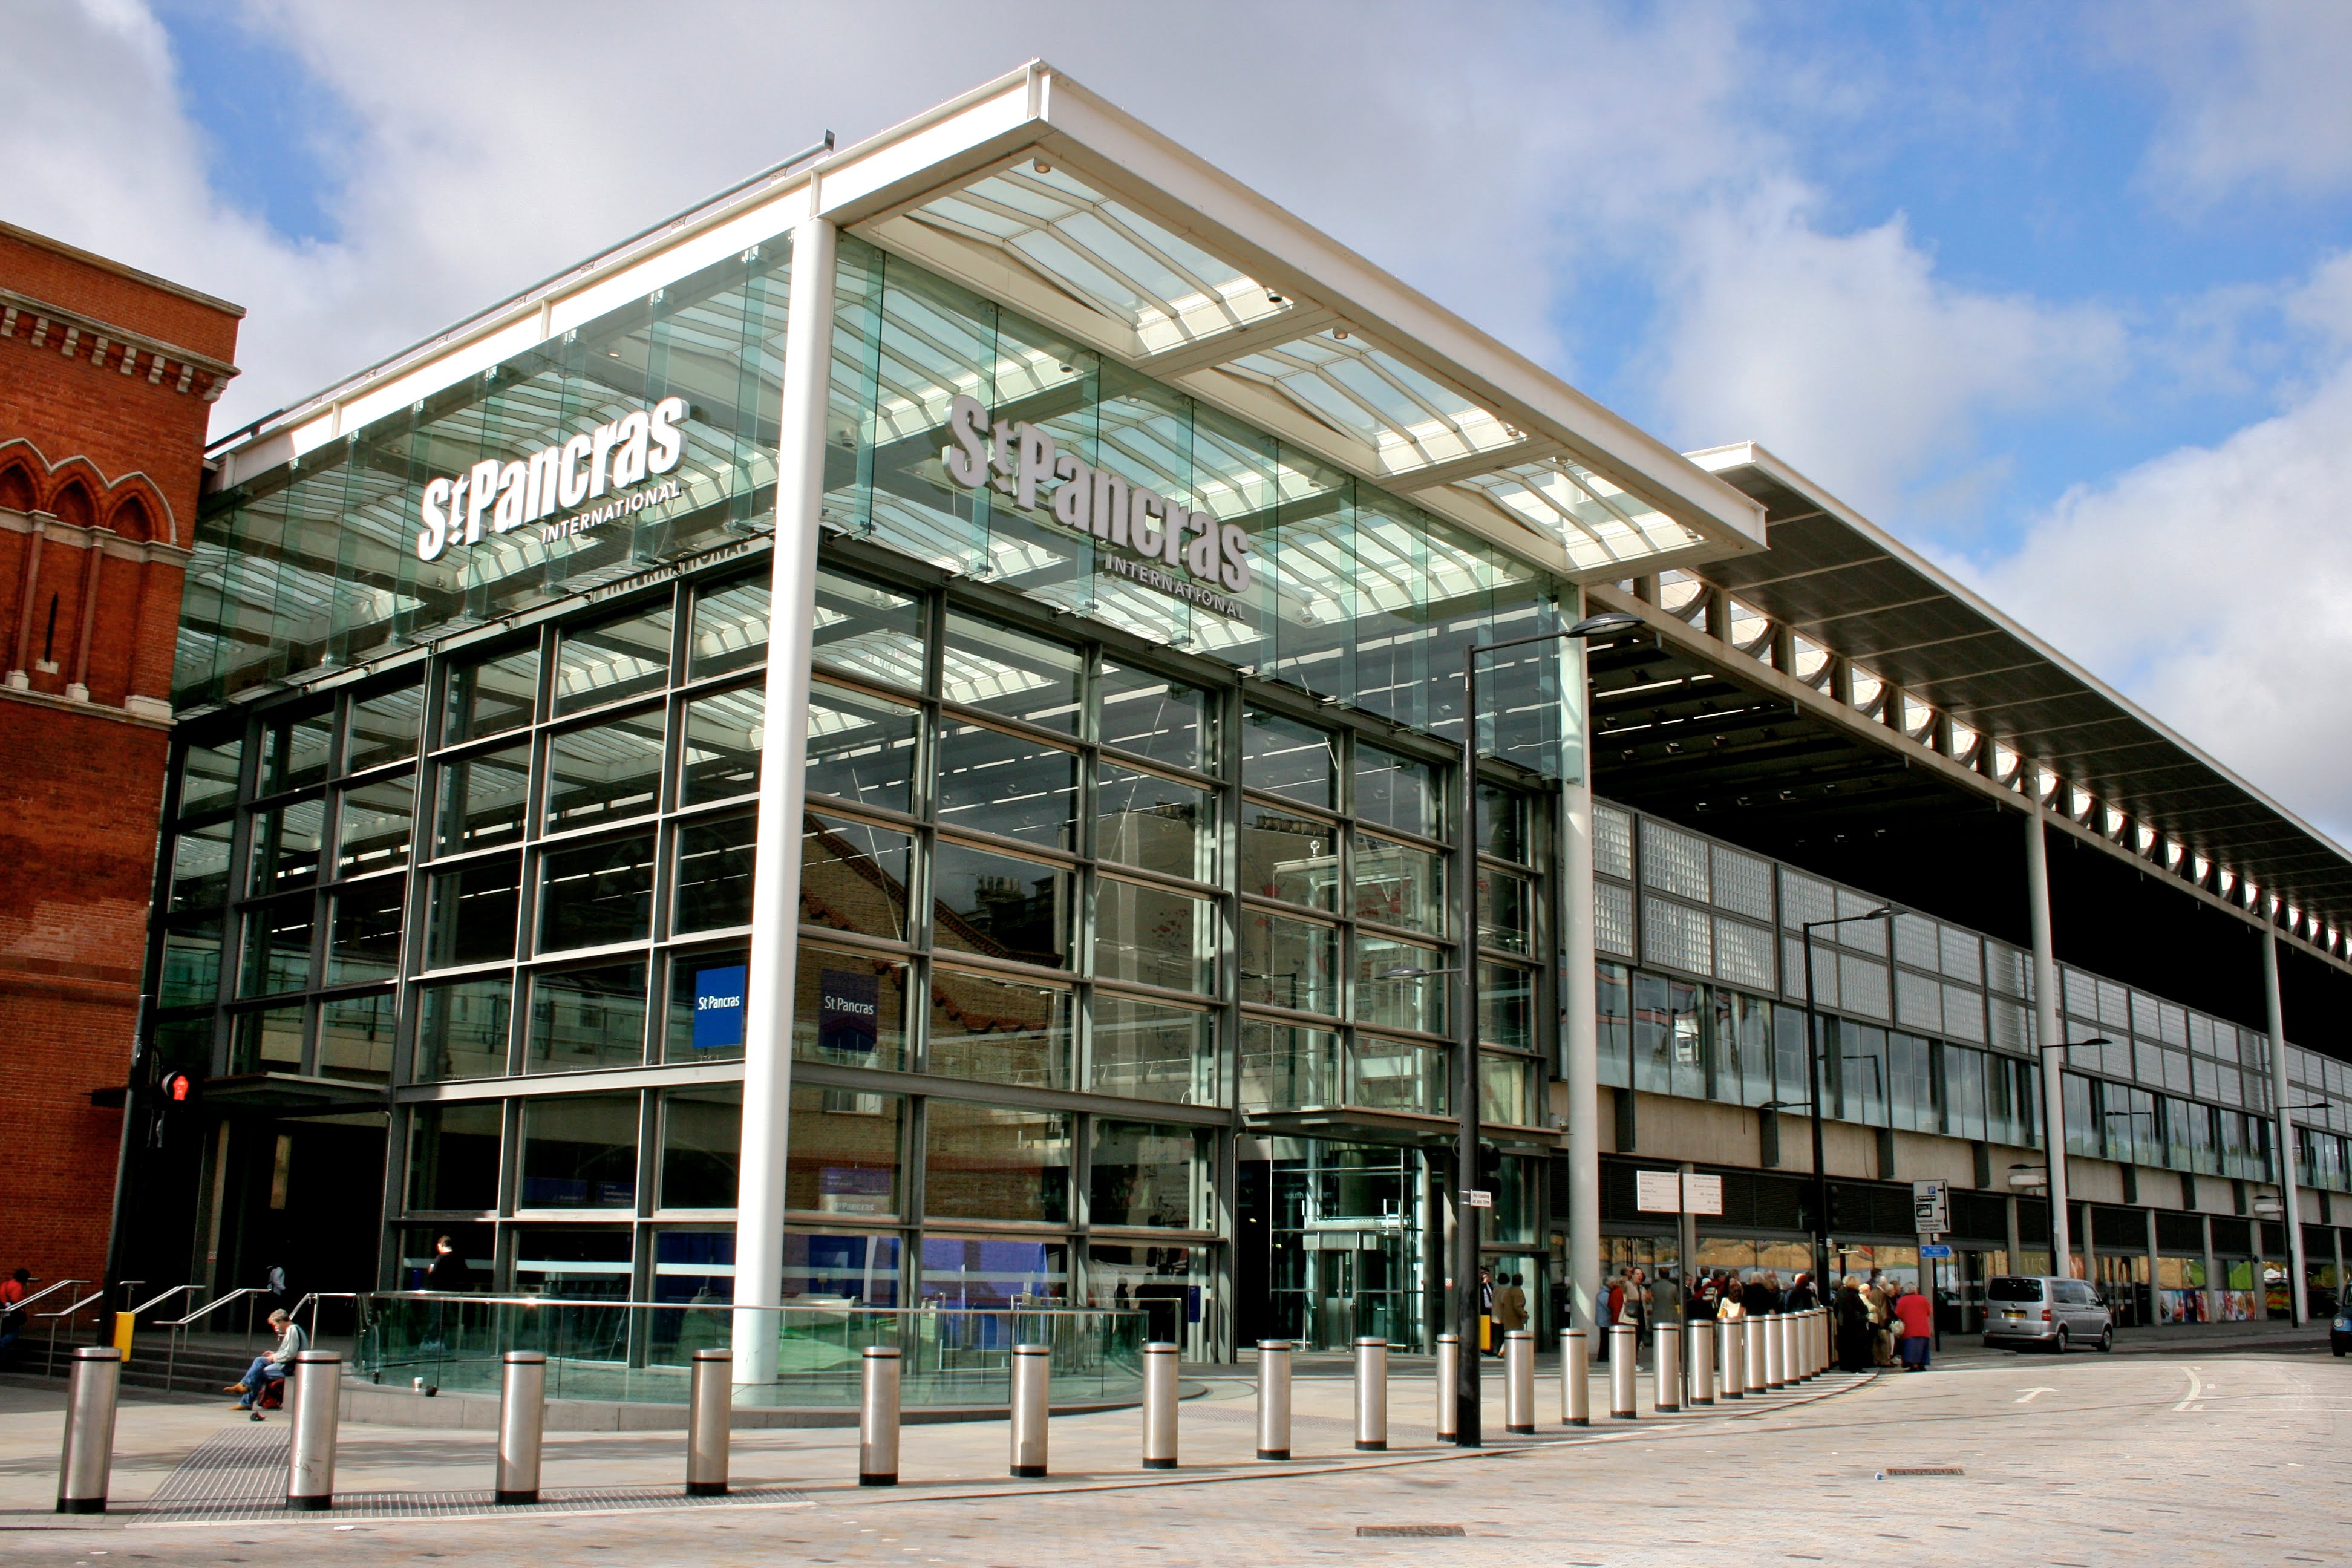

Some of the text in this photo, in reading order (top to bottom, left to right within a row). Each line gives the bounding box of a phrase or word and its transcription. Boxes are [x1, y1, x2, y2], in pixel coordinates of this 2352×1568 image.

[465, 397, 690, 546] Pancras
[541, 480, 682, 544] INTERNATIONAL
[1013, 420, 1250, 593] Pancras
[1105, 553, 1246, 620] INTERNATIONAL
[698, 995, 740, 1011] St Pancras
[825, 995, 874, 1015] St Pancras
